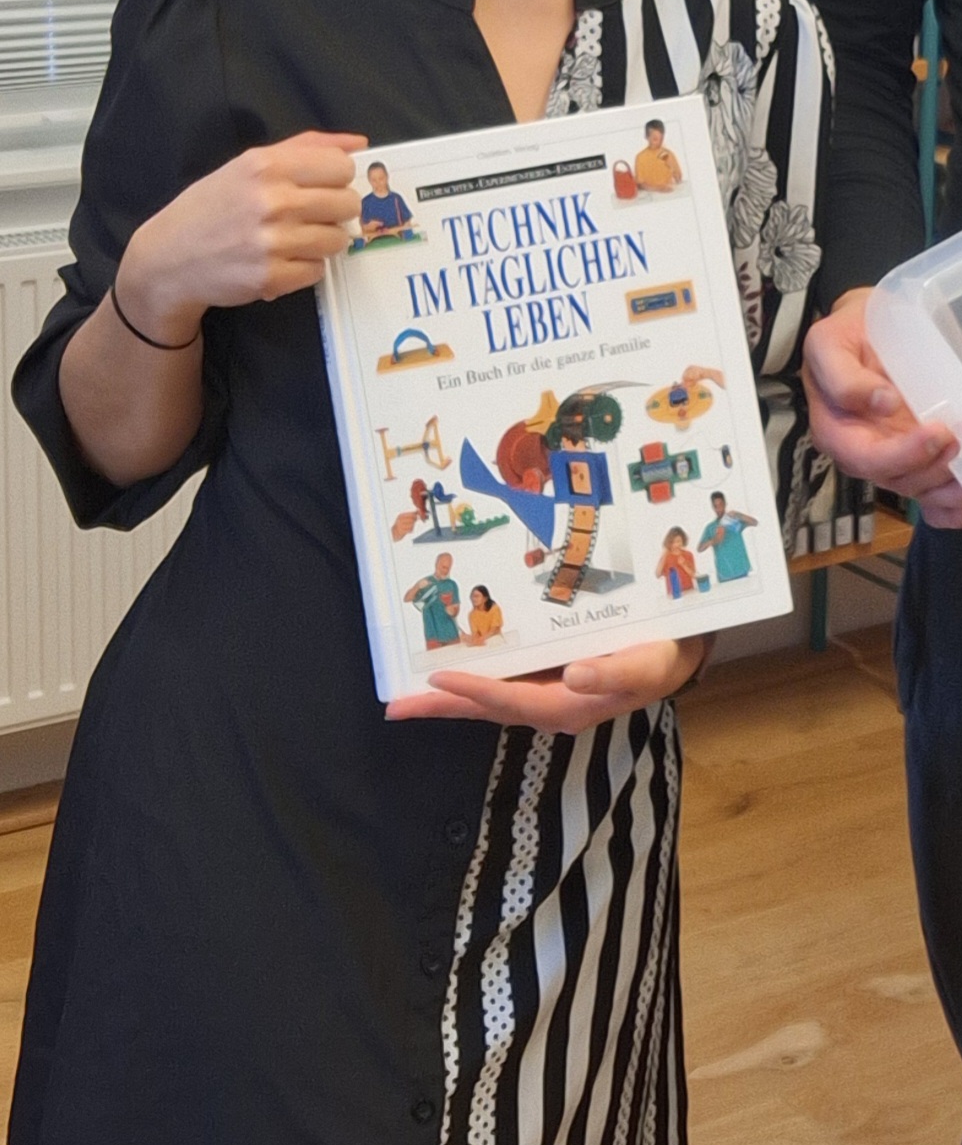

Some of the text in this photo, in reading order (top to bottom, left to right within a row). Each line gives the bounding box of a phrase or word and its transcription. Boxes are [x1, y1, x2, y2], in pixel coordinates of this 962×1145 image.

[442, 192, 599, 261] TECHNIK
[406, 231, 650, 319] IM TÄGLICHEN
[482, 291, 593, 355] LEBEN
[436, 336, 651, 391] Ein Buch für die ganze Familie
[549, 603, 630, 631] Neil Ardley
